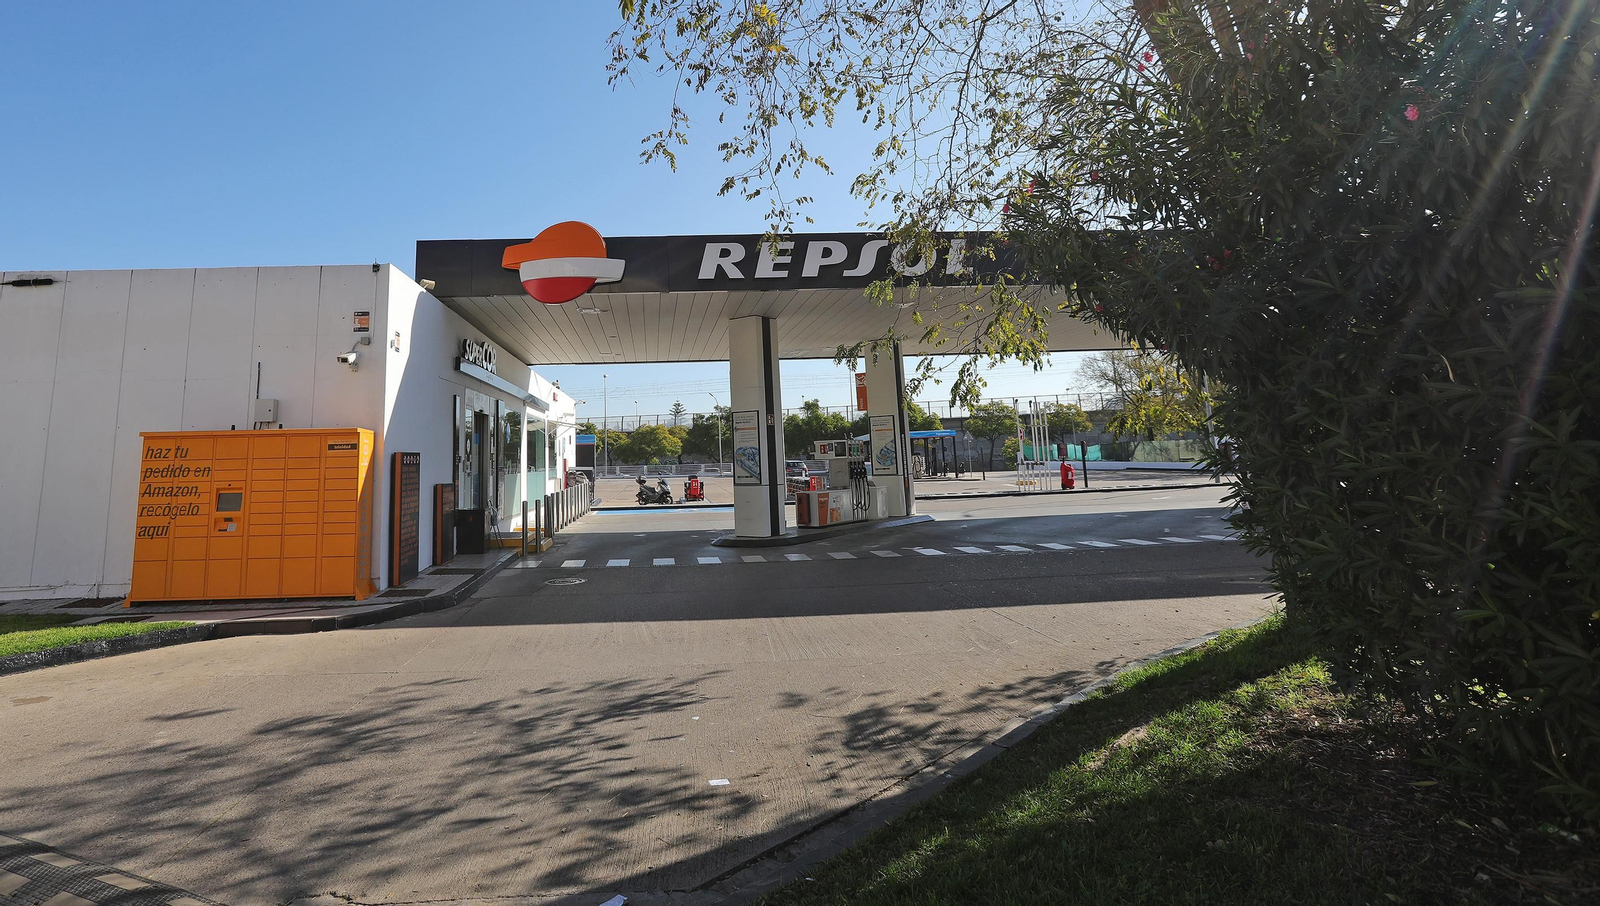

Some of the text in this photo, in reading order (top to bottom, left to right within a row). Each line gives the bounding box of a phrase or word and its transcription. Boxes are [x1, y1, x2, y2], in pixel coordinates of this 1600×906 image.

[697, 239, 974, 280] REPSOL
[145, 446, 189, 459] haz tu
[142, 464, 211, 481] pedido en
[141, 483, 201, 499] Amazon,
[140, 502, 200, 520] recógelo
[138, 521, 171, 540] aquí
